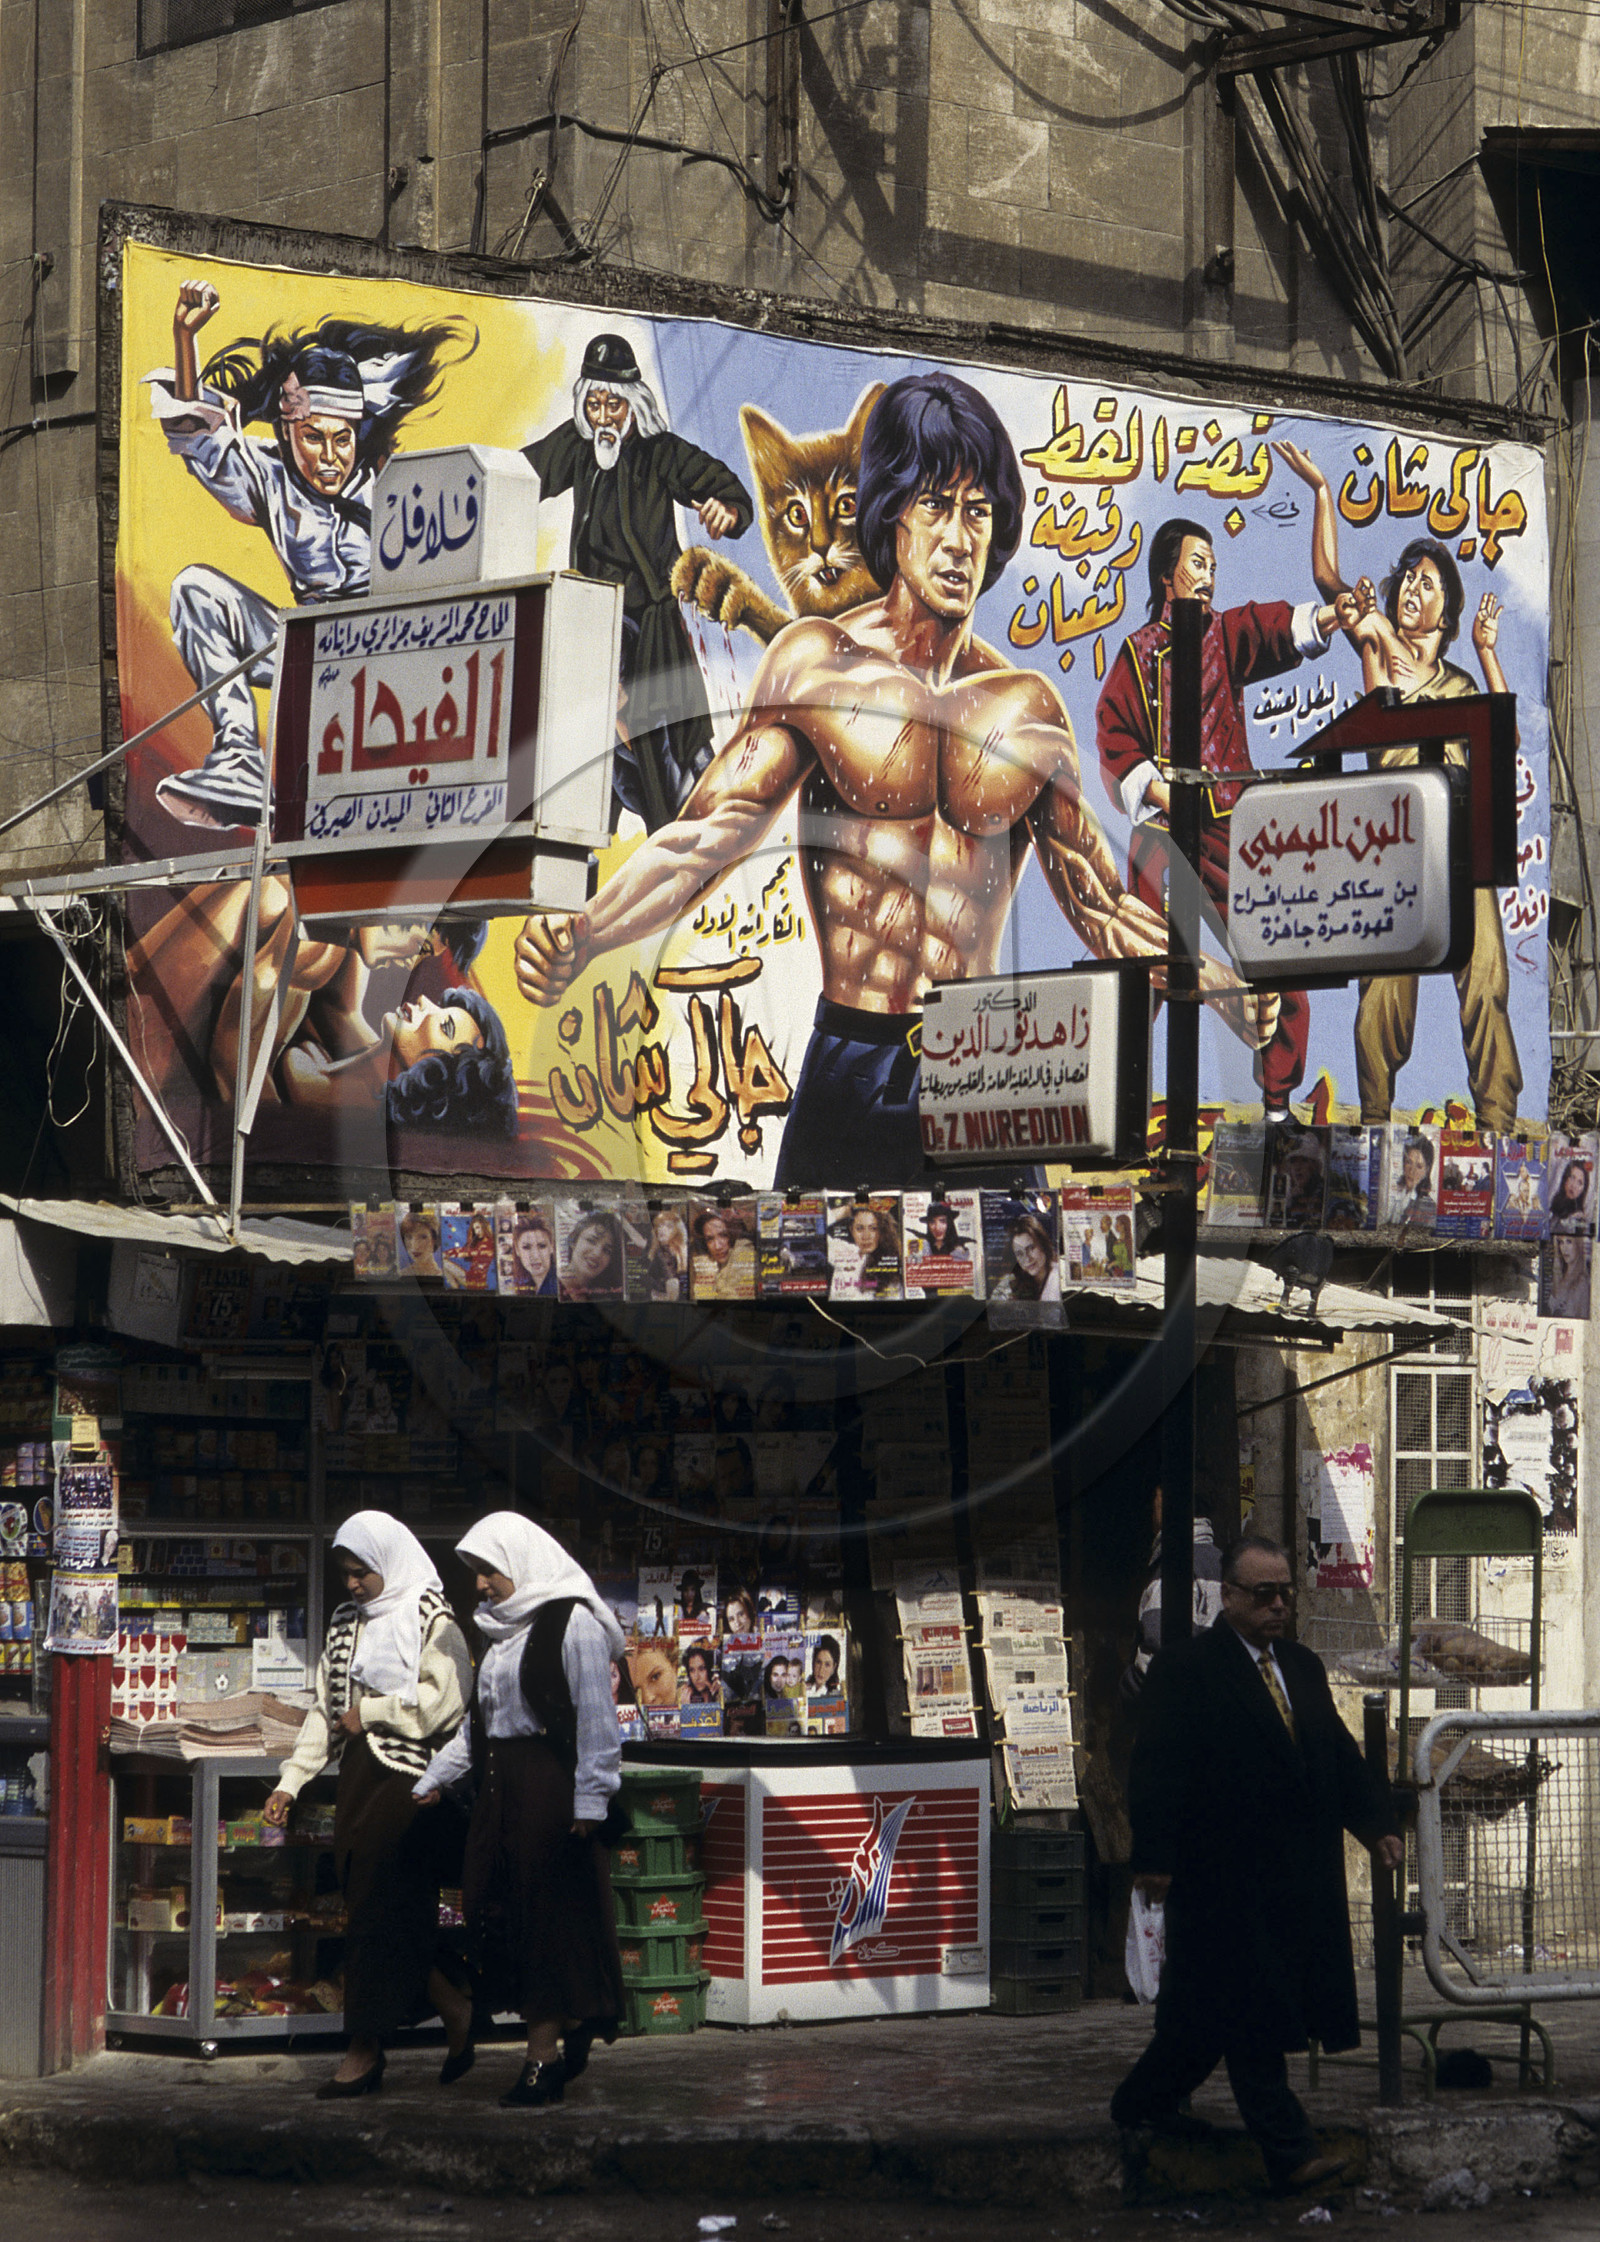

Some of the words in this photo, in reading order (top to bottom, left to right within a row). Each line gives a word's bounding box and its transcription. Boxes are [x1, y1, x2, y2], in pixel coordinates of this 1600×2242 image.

[1020, 384, 1170, 485] القط
[1337, 435, 1431, 526] شان
[378, 473, 480, 571] فلافل
[446, 601, 481, 645] محمد
[316, 647, 505, 786] الفيحاء
[1237, 798, 1344, 876] اليمني
[1345, 792, 1417, 867] البن
[1326, 879, 1385, 907] سكاكر
[1393, 880, 1419, 906] بن
[1260, 917, 1315, 950] جاهزة
[1317, 914, 1348, 942] مرة
[1351, 907, 1395, 936] قهوة
[972, 988, 1038, 1014] الدكتور
[921, 1012, 991, 1068] الدين
